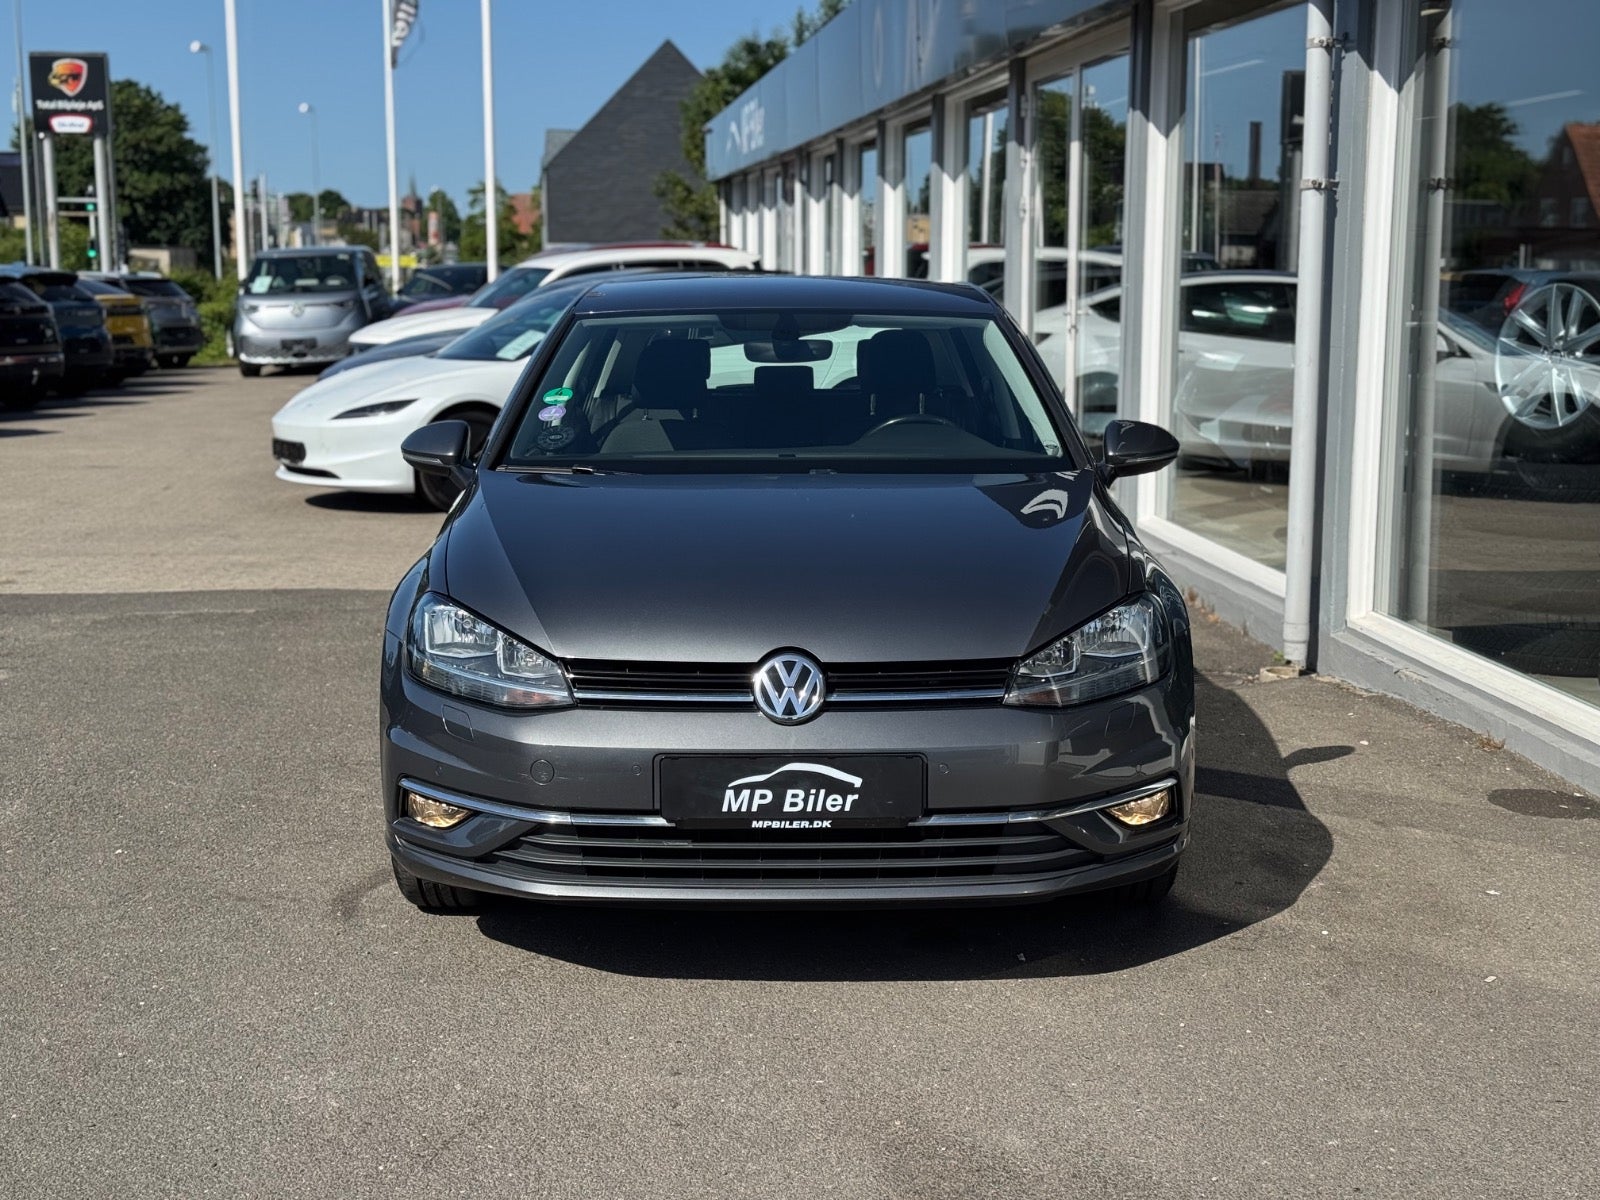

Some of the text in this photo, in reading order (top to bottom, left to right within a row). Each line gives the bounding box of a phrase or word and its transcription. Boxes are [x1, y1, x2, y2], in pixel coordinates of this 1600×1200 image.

[36, 99, 56, 110] Total
[757, 655, 822, 718] VW
[721, 788, 860, 813] MP Biler
[751, 819, 833, 829] MPBILER.DK
